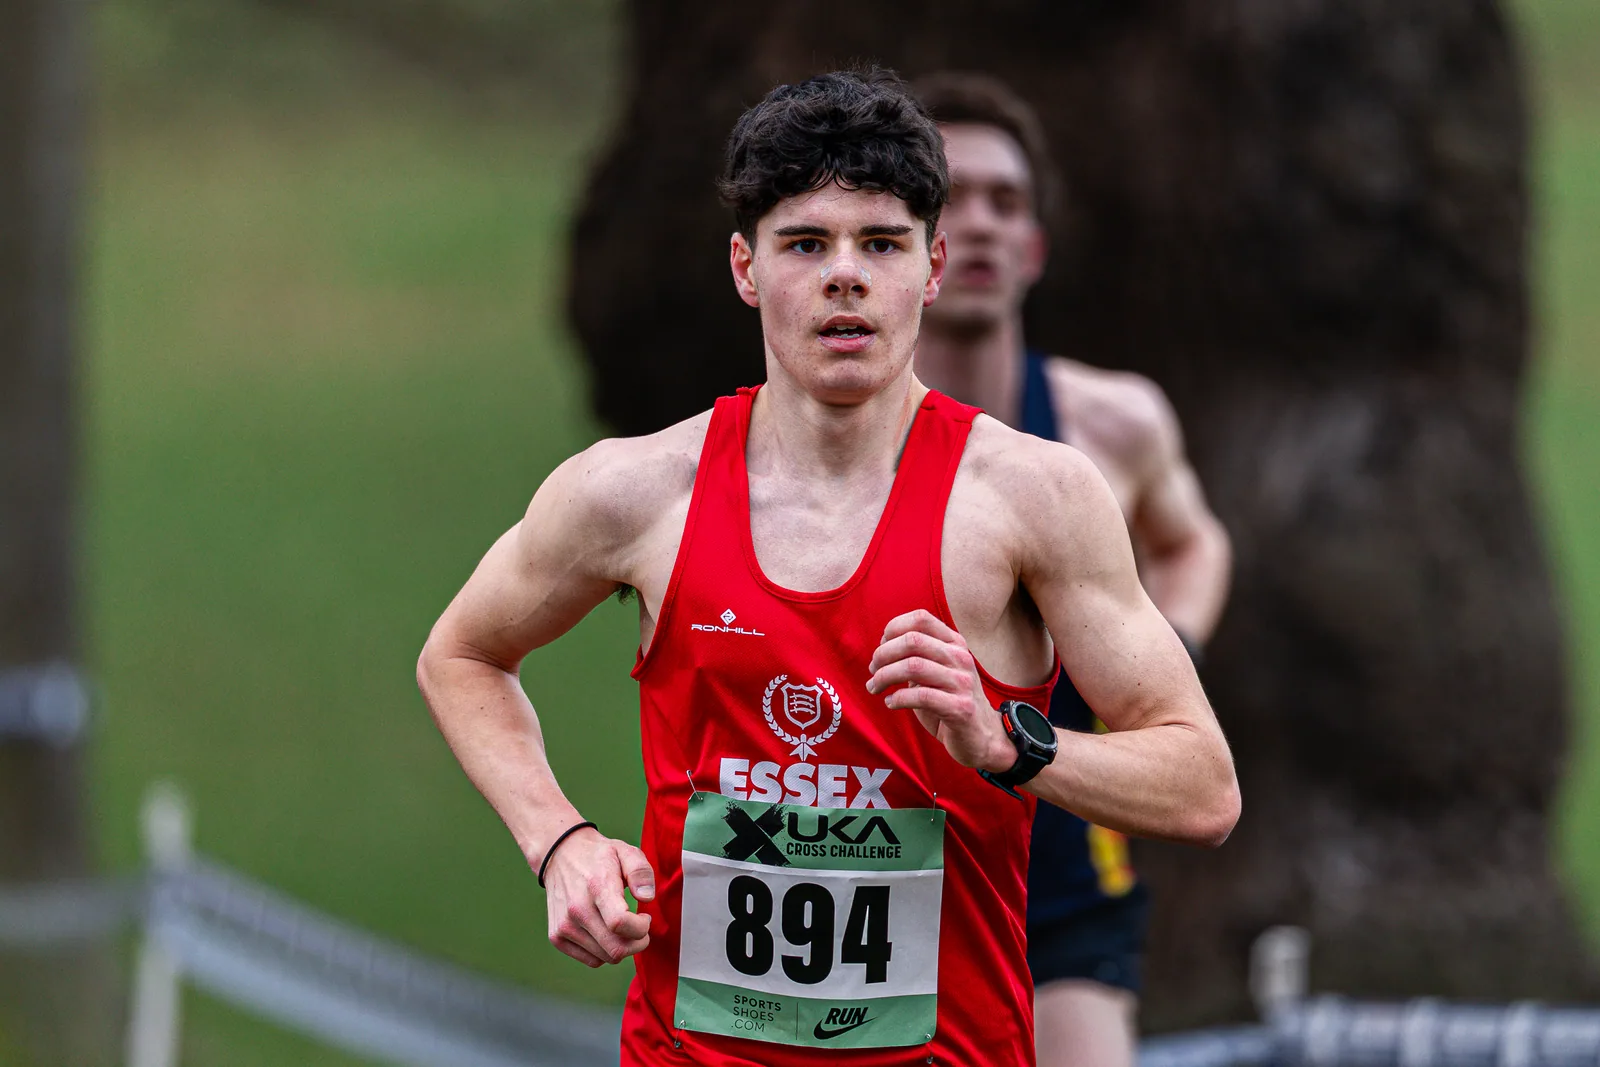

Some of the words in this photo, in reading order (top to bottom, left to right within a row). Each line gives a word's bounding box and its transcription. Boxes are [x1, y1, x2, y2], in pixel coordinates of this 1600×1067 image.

[691, 624, 765, 636] RONHILL
[719, 757, 893, 809] ESSEX
[787, 811, 901, 844] UKA
[786, 842, 827, 857] CROSS
[830, 844, 902, 859] CHALLENGE
[725, 875, 893, 984] 894
[733, 994, 782, 1012] SPORTS
[733, 1006, 774, 1022] SHOES
[824, 1007, 869, 1025] RUN
[731, 1018, 765, 1032] .COM
